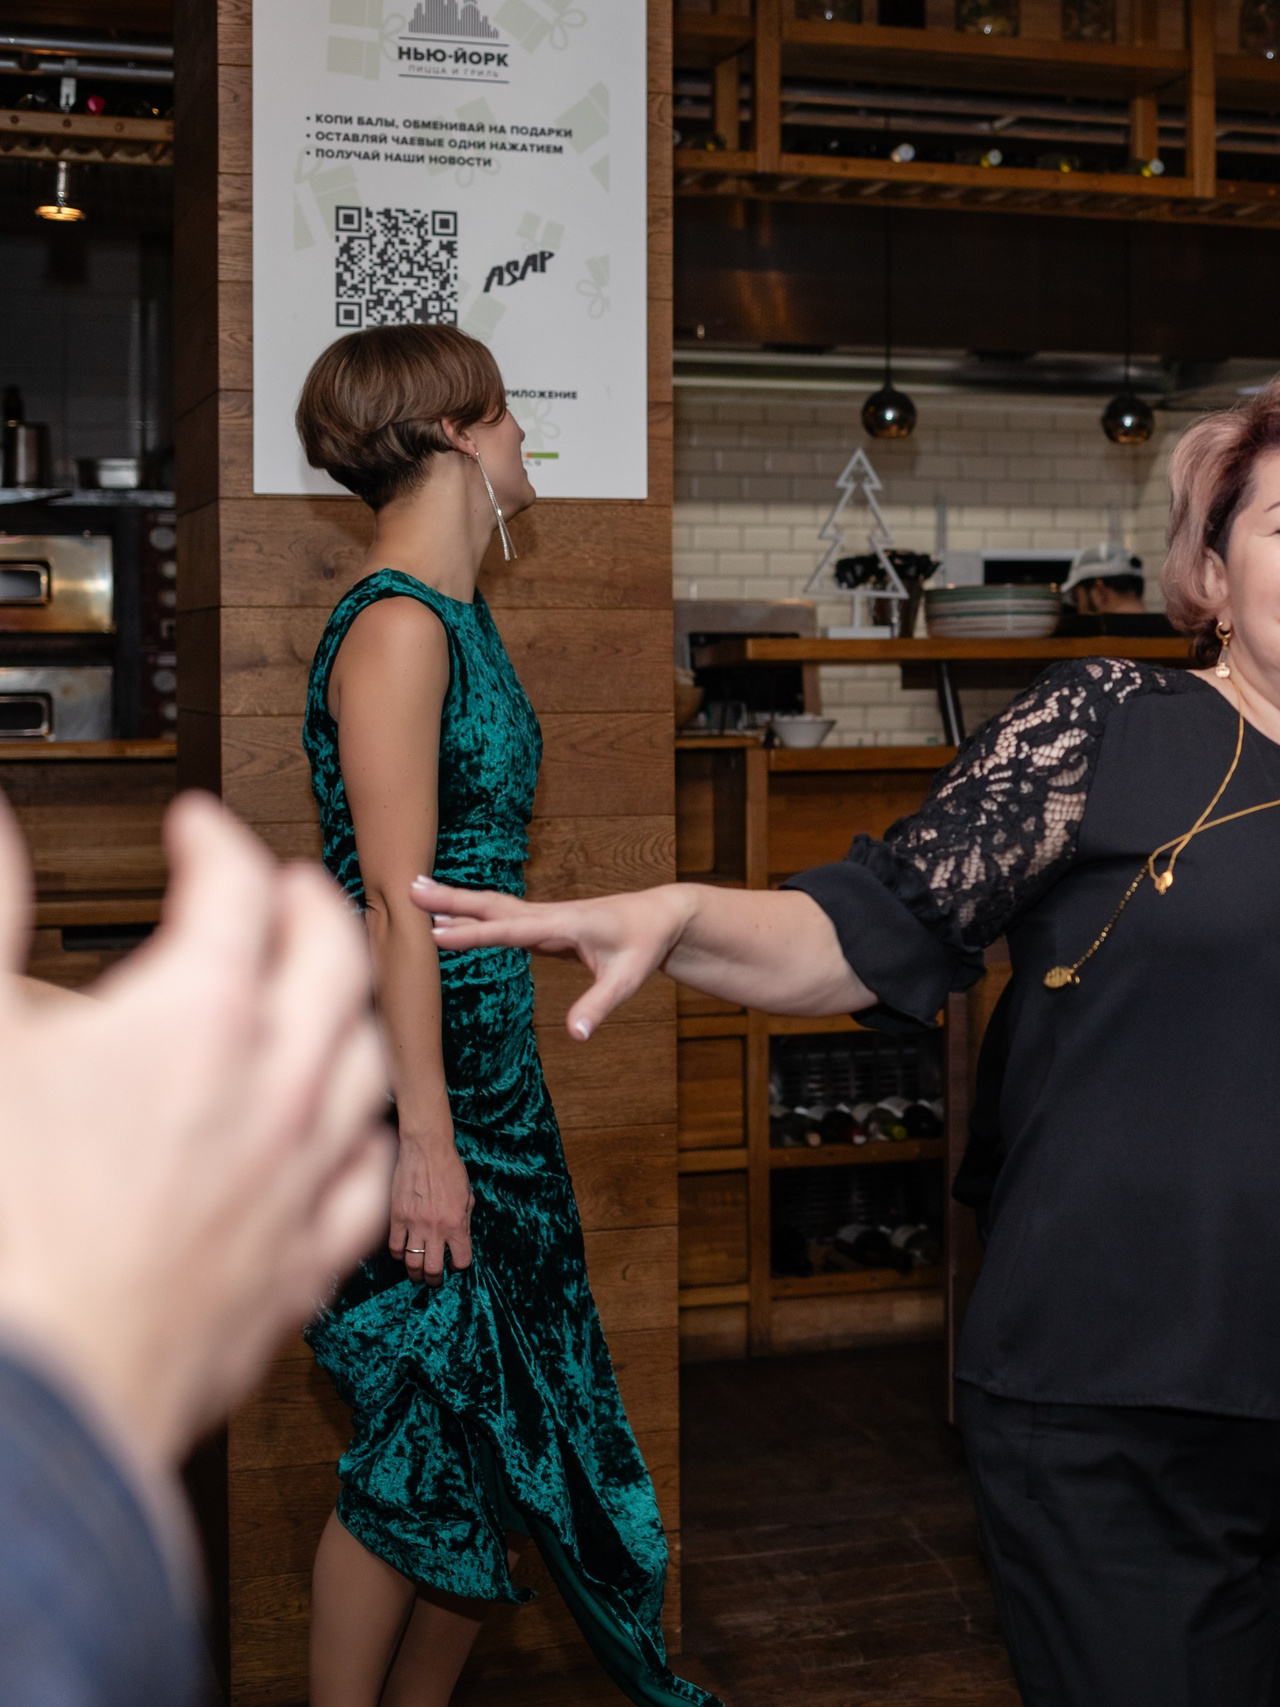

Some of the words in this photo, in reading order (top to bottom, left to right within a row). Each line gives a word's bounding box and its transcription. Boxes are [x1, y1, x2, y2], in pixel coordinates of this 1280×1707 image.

[398, 46, 509, 67] НЬЮ-ЙОРК
[408, 64, 447, 75] ПИЦЦА
[464, 68, 499, 78] ГРИЛЬ
[315, 114, 353, 125] КОПИ
[357, 116, 399, 129] БАЛЫ,
[402, 119, 485, 133] ОБМЕНИВАЙ
[489, 125, 506, 134] НА
[510, 126, 573, 138] ПОДАРКИ
[315, 131, 388, 144] ОСТАВЛЯЙ
[391, 136, 445, 148] ЧАЕВЫЕ
[448, 139, 486, 150] ОДНИ
[489, 142, 564, 154] НАЖАТИЕМ
[315, 148, 380, 161] ПОЛУЧАЙ
[384, 153, 425, 163] НАШИ
[428, 155, 492, 167] НОВОСТИ
[483, 250, 555, 293] ASAP
[505, 389, 578, 399] РИЛОЖЕНИЕ
